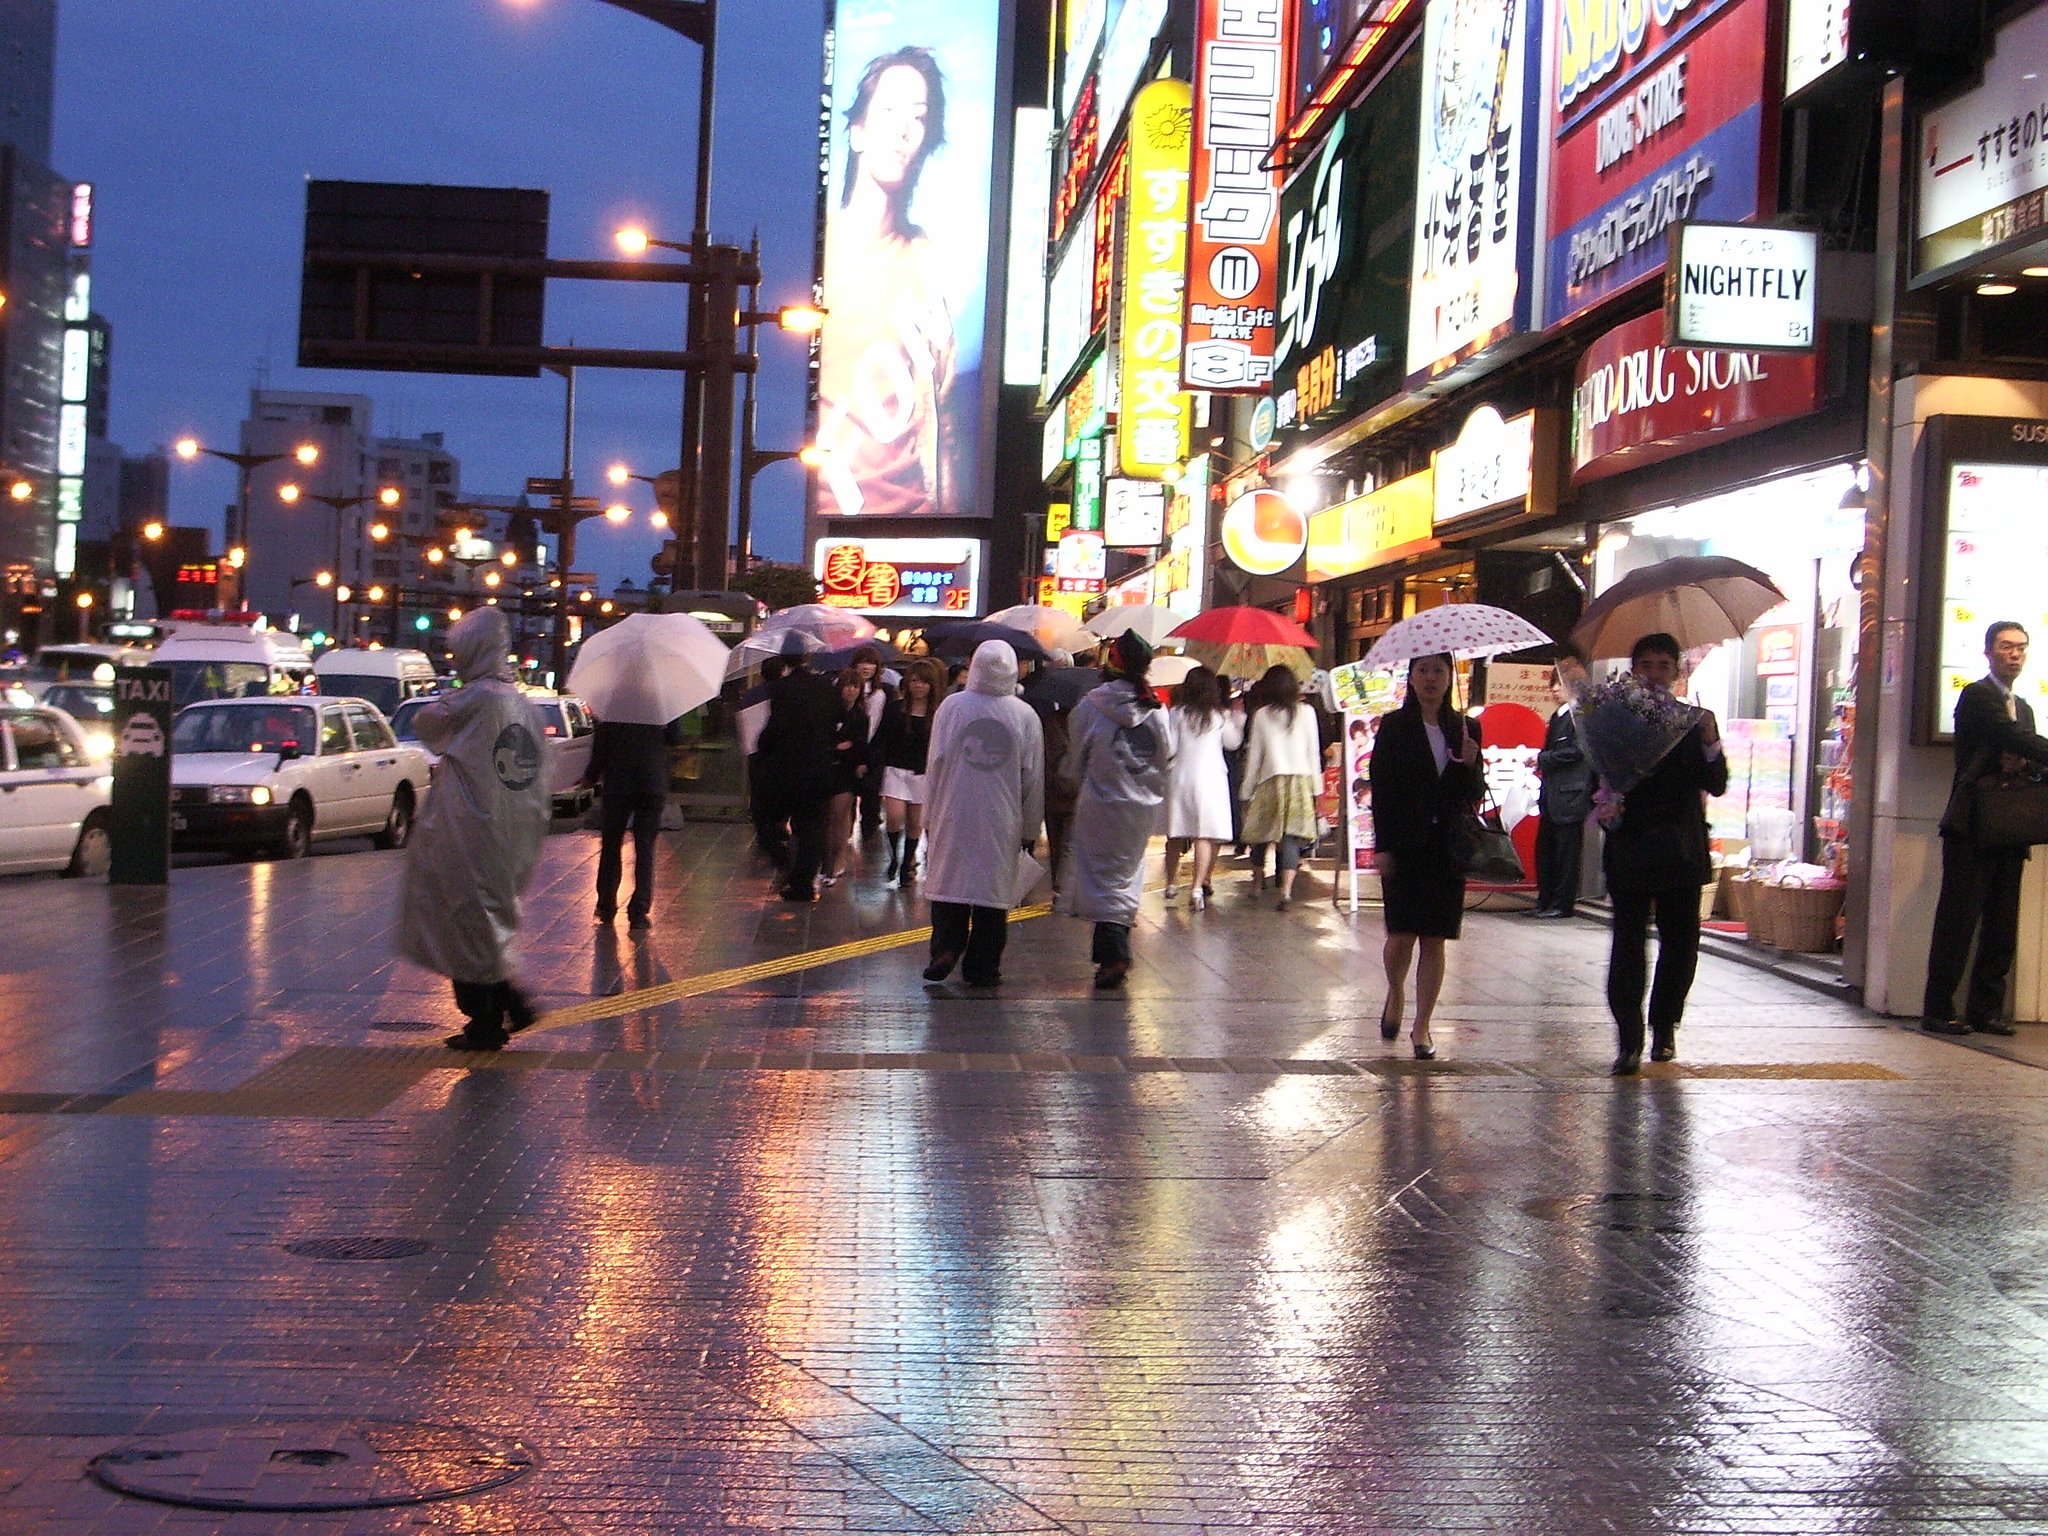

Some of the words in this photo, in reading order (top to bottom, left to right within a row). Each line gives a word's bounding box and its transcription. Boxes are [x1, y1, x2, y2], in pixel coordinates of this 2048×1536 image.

[1595, 98, 1634, 173] DRUG
[1635, 54, 1687, 144] STORE
[1685, 263, 1807, 301] NIGHTFLY
[1190, 303, 1237, 326] Media
[1237, 305, 1274, 328] Cafe
[1788, 321, 1809, 342] B1
[1617, 345, 1675, 415] DRUG
[2012, 424, 2048, 444] SUS
[946, 588, 970, 609] 2F
[116, 678, 170, 702] TAXI
